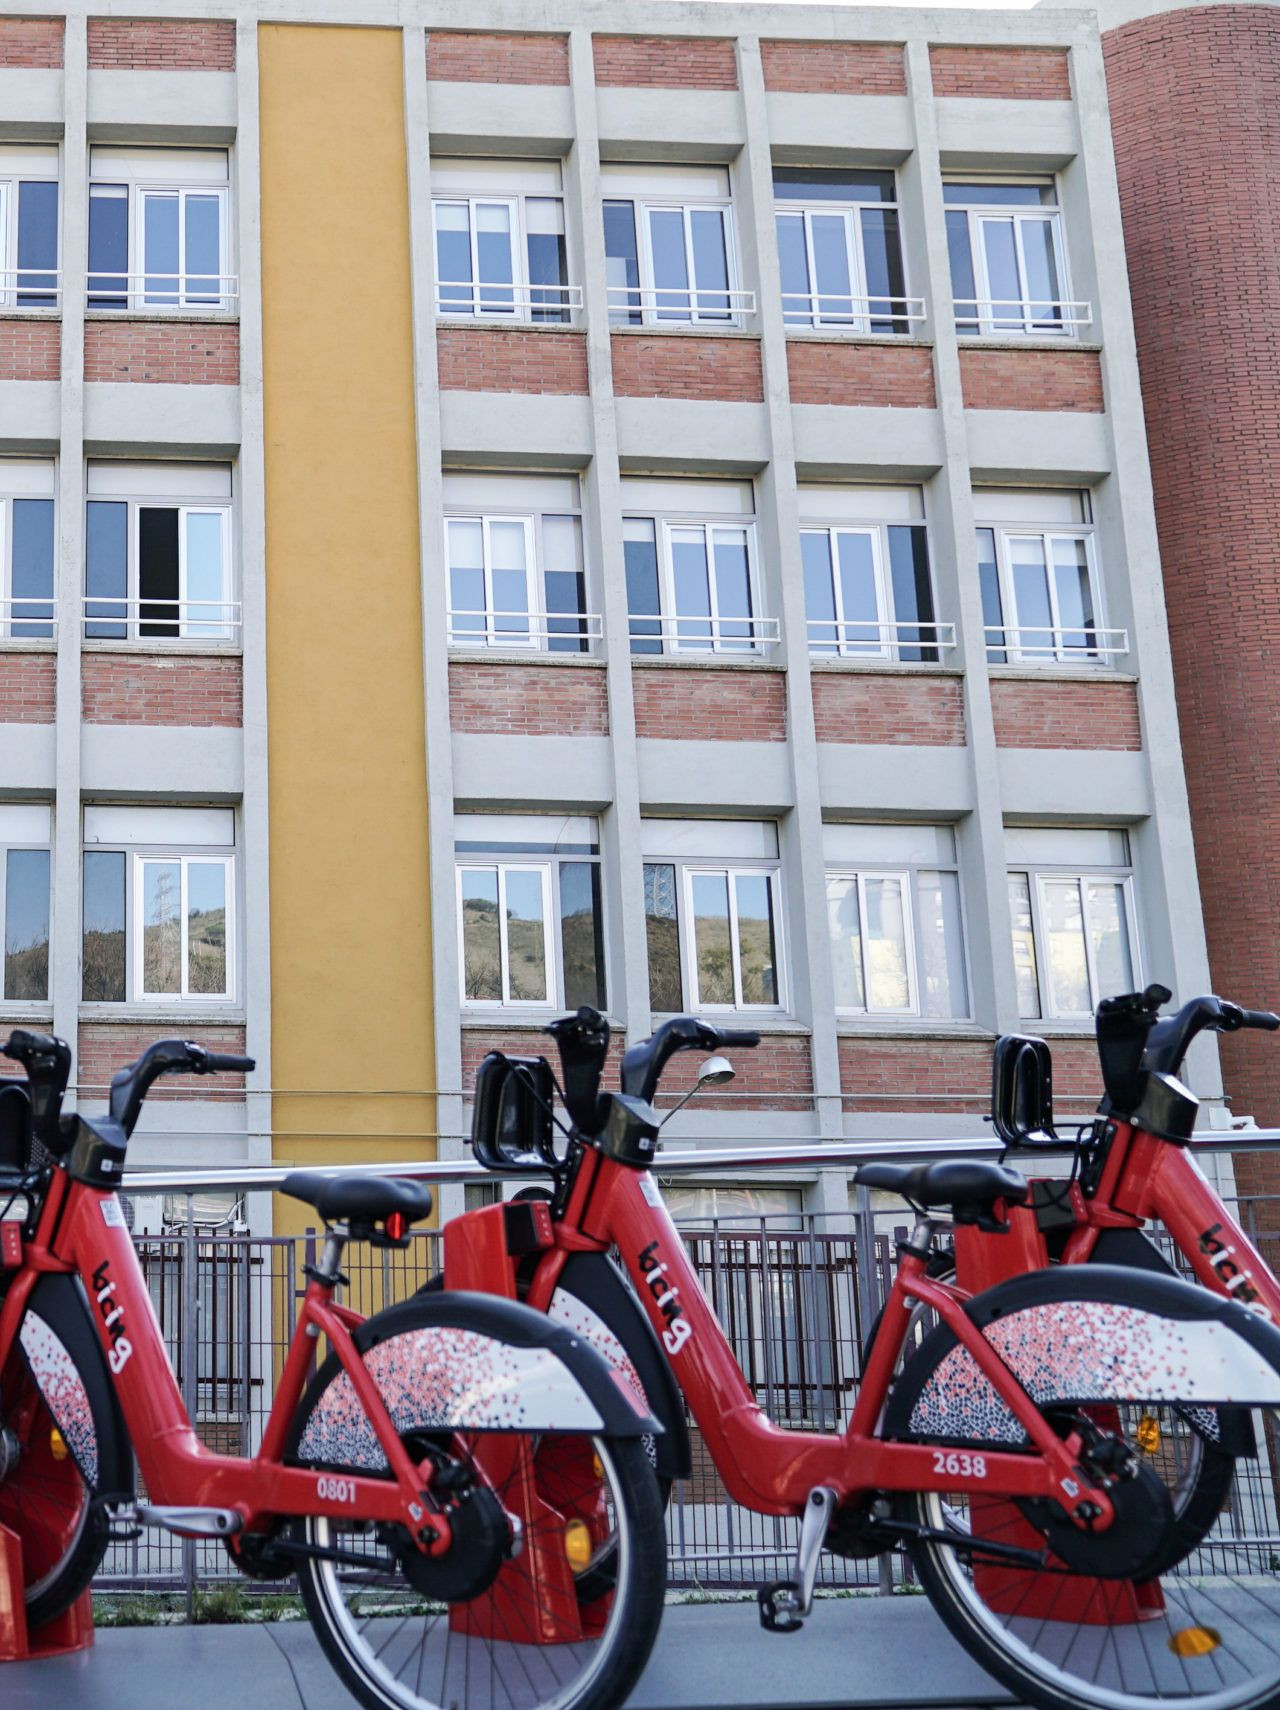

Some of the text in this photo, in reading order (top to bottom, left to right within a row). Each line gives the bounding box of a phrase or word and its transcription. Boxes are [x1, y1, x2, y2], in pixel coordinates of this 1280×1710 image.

[92, 1259, 133, 1374] bicing
[638, 1240, 692, 1355] bicing
[316, 1476, 356, 1504] 0801
[932, 1451, 987, 1478] 2638
